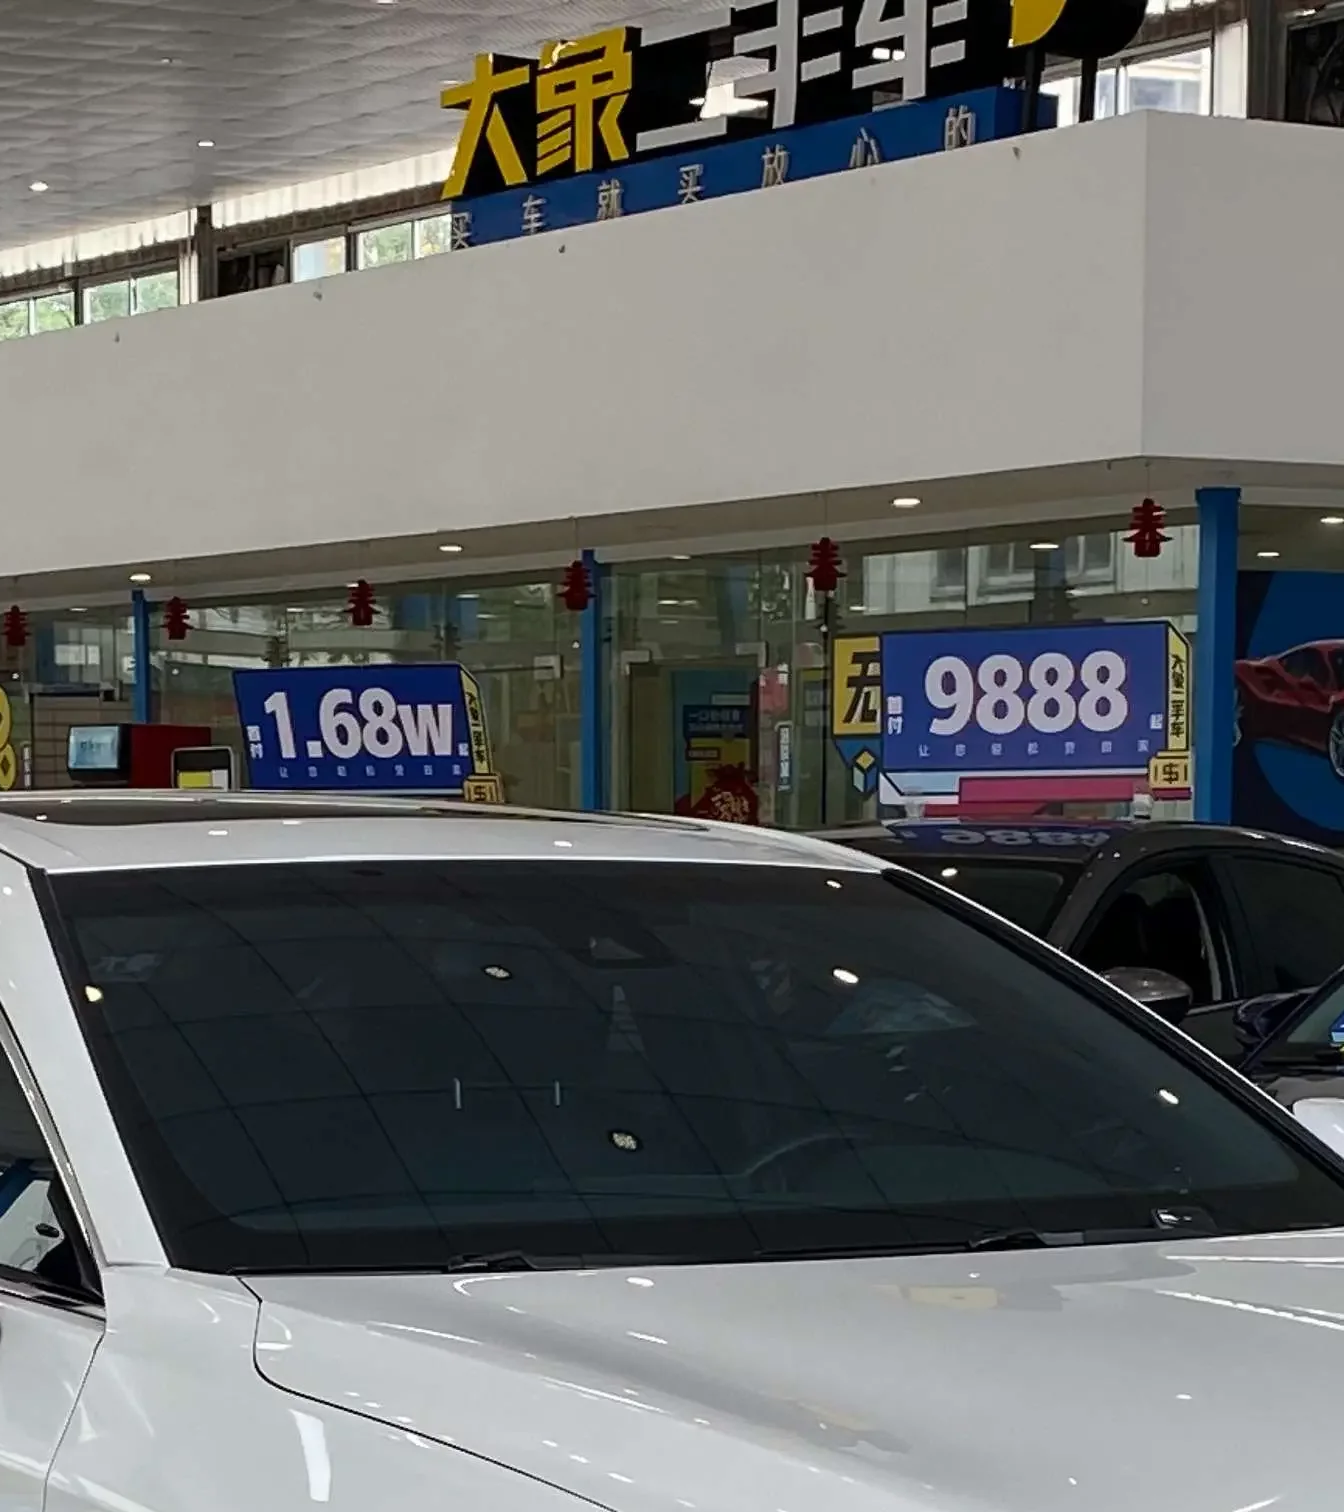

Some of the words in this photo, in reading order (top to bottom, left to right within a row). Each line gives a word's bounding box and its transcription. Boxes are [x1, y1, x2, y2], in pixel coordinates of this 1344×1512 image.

[441, 0, 969, 200] 大象二手车
[452, 104, 975, 250] 买车就买放心的
[924, 650, 1128, 737] 9888
